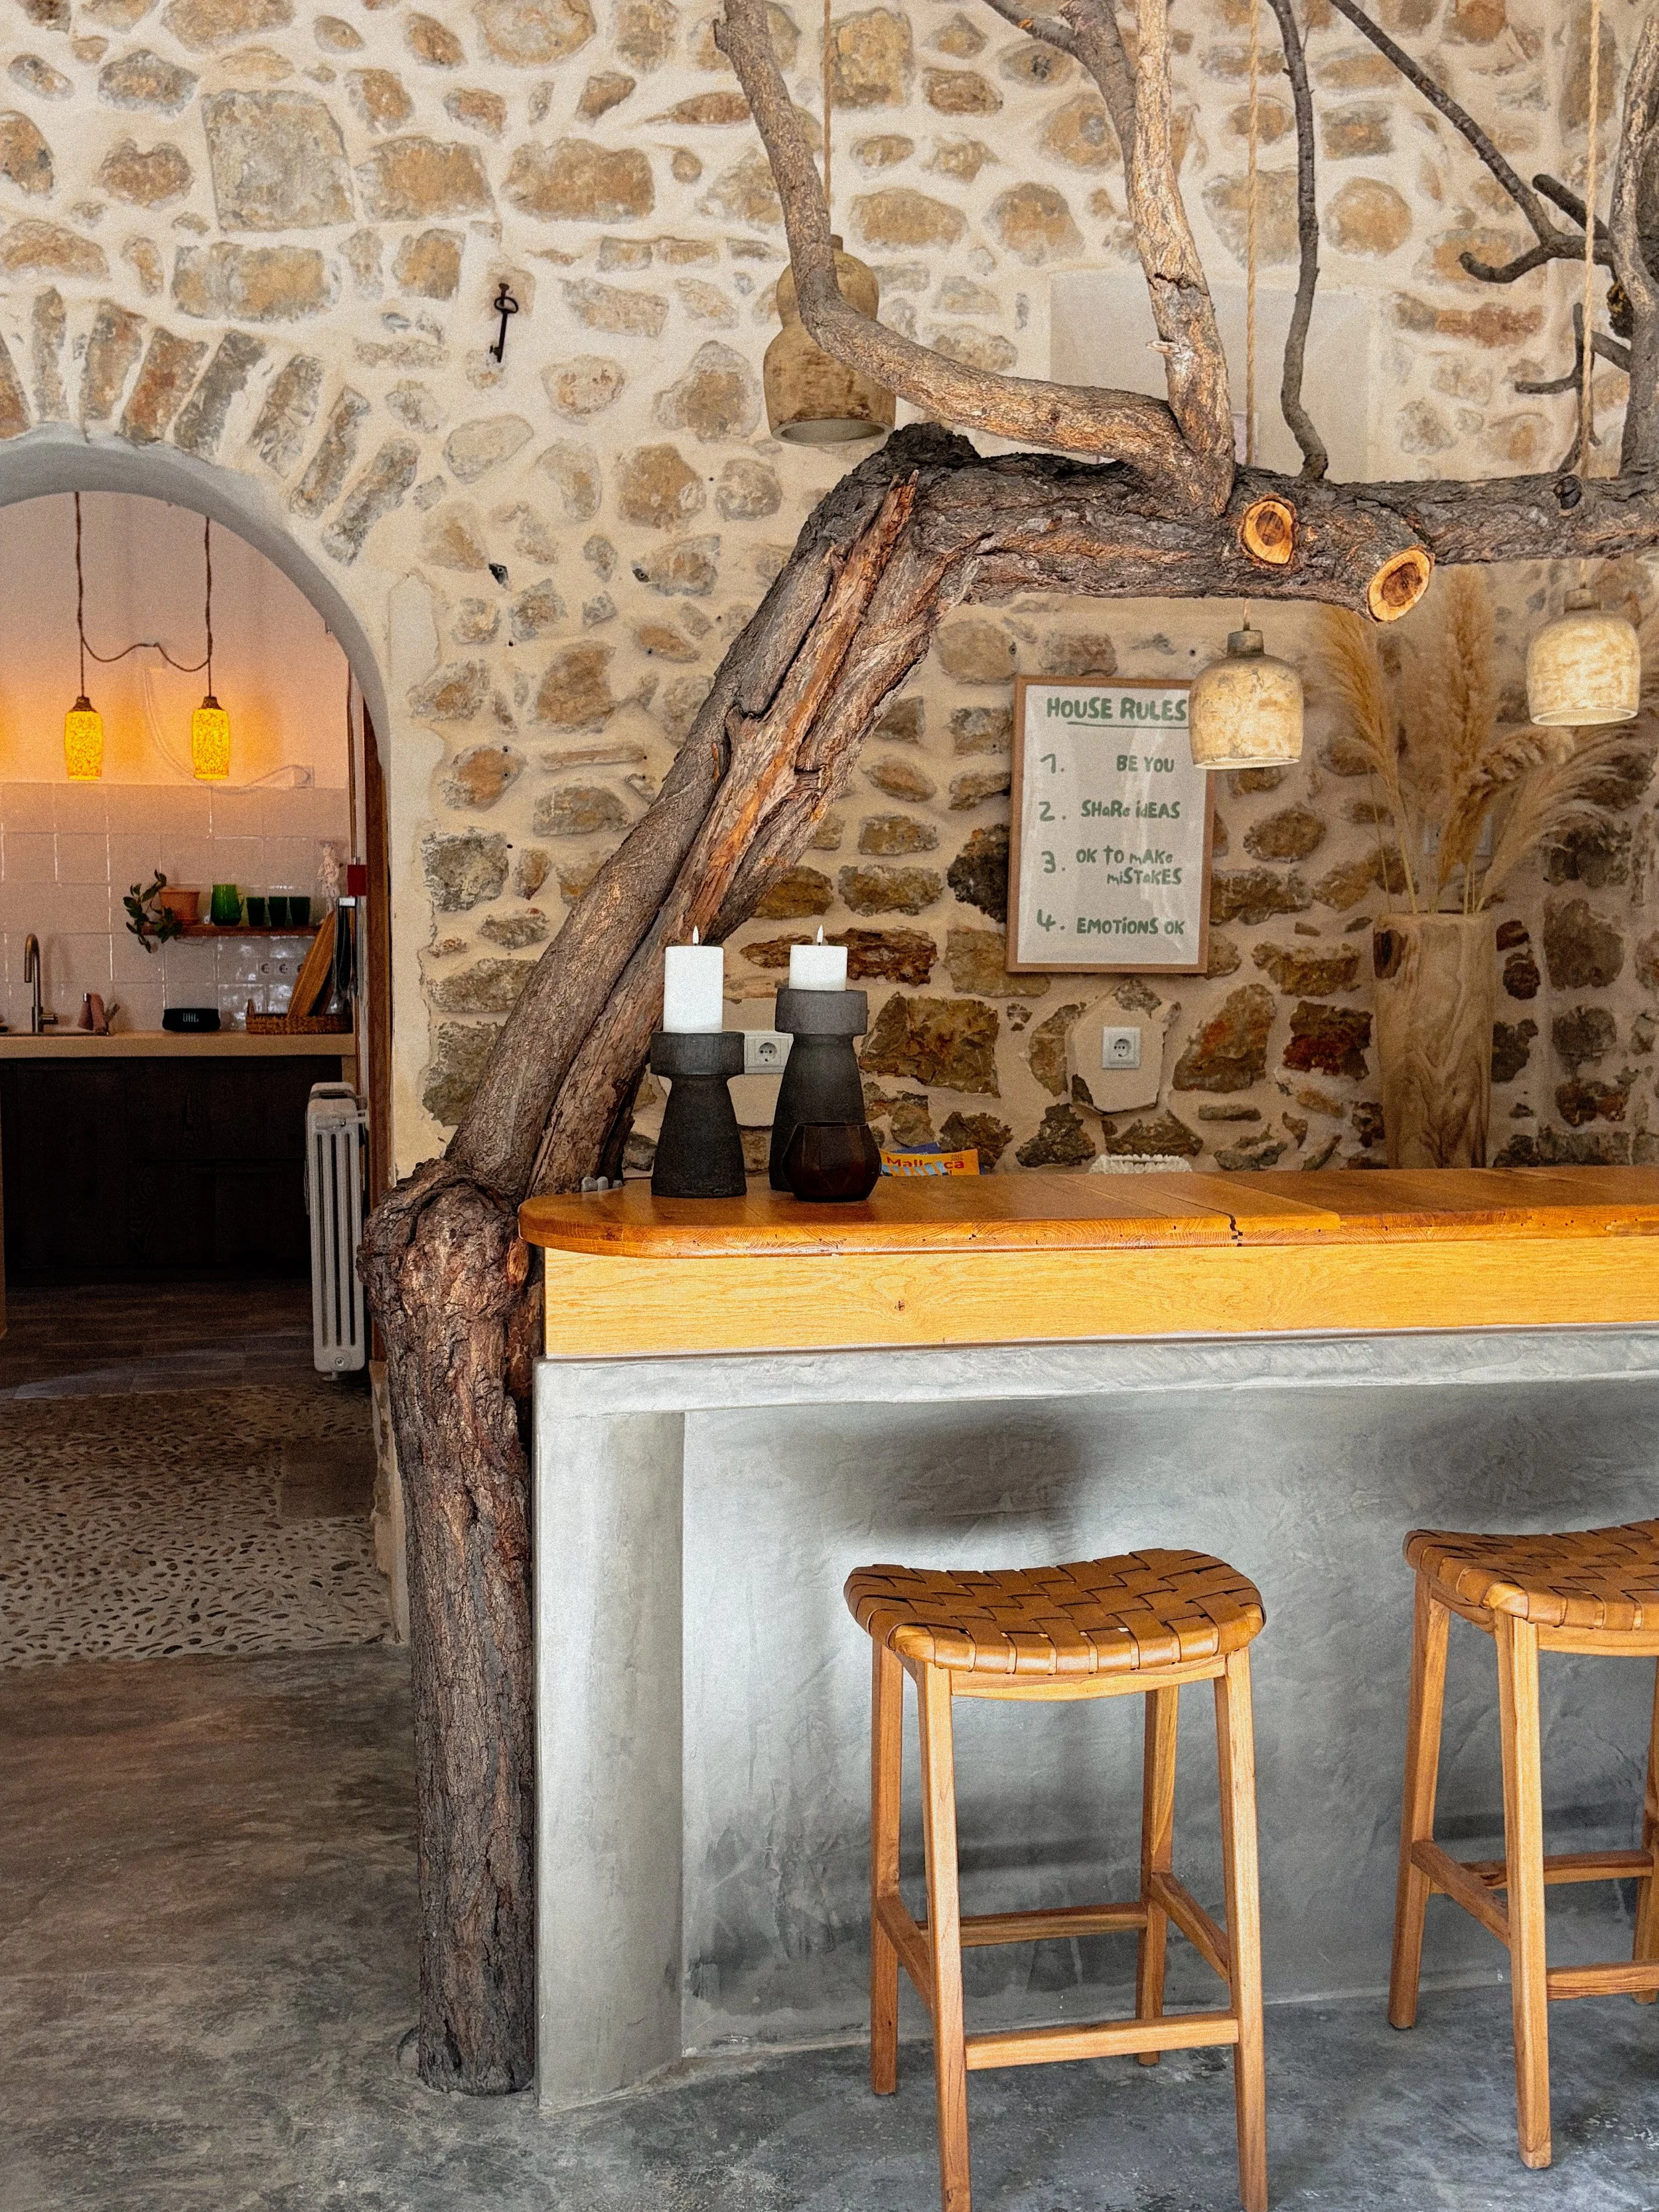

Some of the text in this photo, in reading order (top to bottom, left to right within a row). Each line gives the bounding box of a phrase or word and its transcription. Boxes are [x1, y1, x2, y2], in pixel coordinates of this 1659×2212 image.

[1046, 696, 1187, 722] HOUSE RULES
[1040, 753, 1175, 774] 1. BE YOU
[1039, 800, 1066, 822] 2.
[1041, 849, 1066, 874] 3.
[1076, 848, 1097, 863] OK
[1037, 909, 1065, 932] 4.
[1164, 920, 1185, 935] OK
